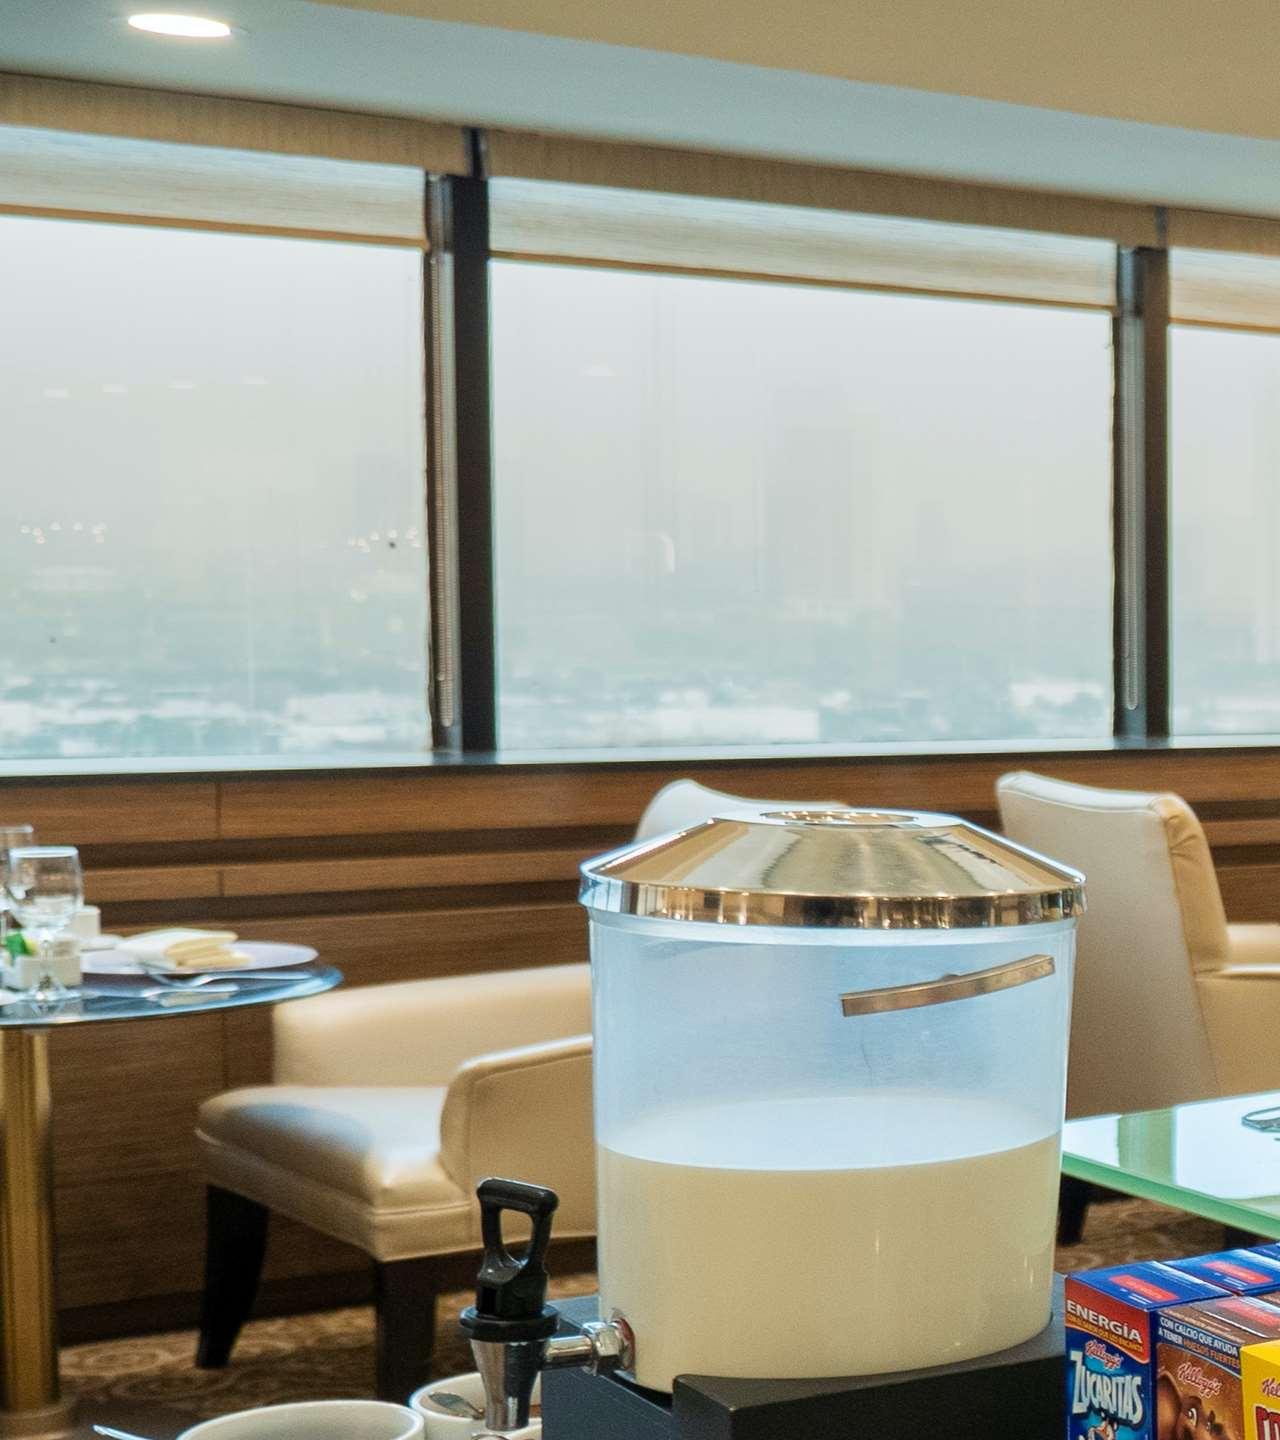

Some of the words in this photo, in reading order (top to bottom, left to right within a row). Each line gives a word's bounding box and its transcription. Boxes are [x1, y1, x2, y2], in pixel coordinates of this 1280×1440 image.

[1066, 1300, 1143, 1344] ENERGÍA
[1160, 1316, 1174, 1332] CON
[1175, 1322, 1199, 1340] CALCIO
[1199, 1333, 1213, 1348] QUE
[1213, 1338, 1239, 1357] AYUDA
[1164, 1329, 1183, 1345] TENER
[1085, 1339, 1121, 1370] Kellogg's
[1070, 1350, 1144, 1426] ZUCARITAS
[1177, 1362, 1223, 1399] Kellogg's
